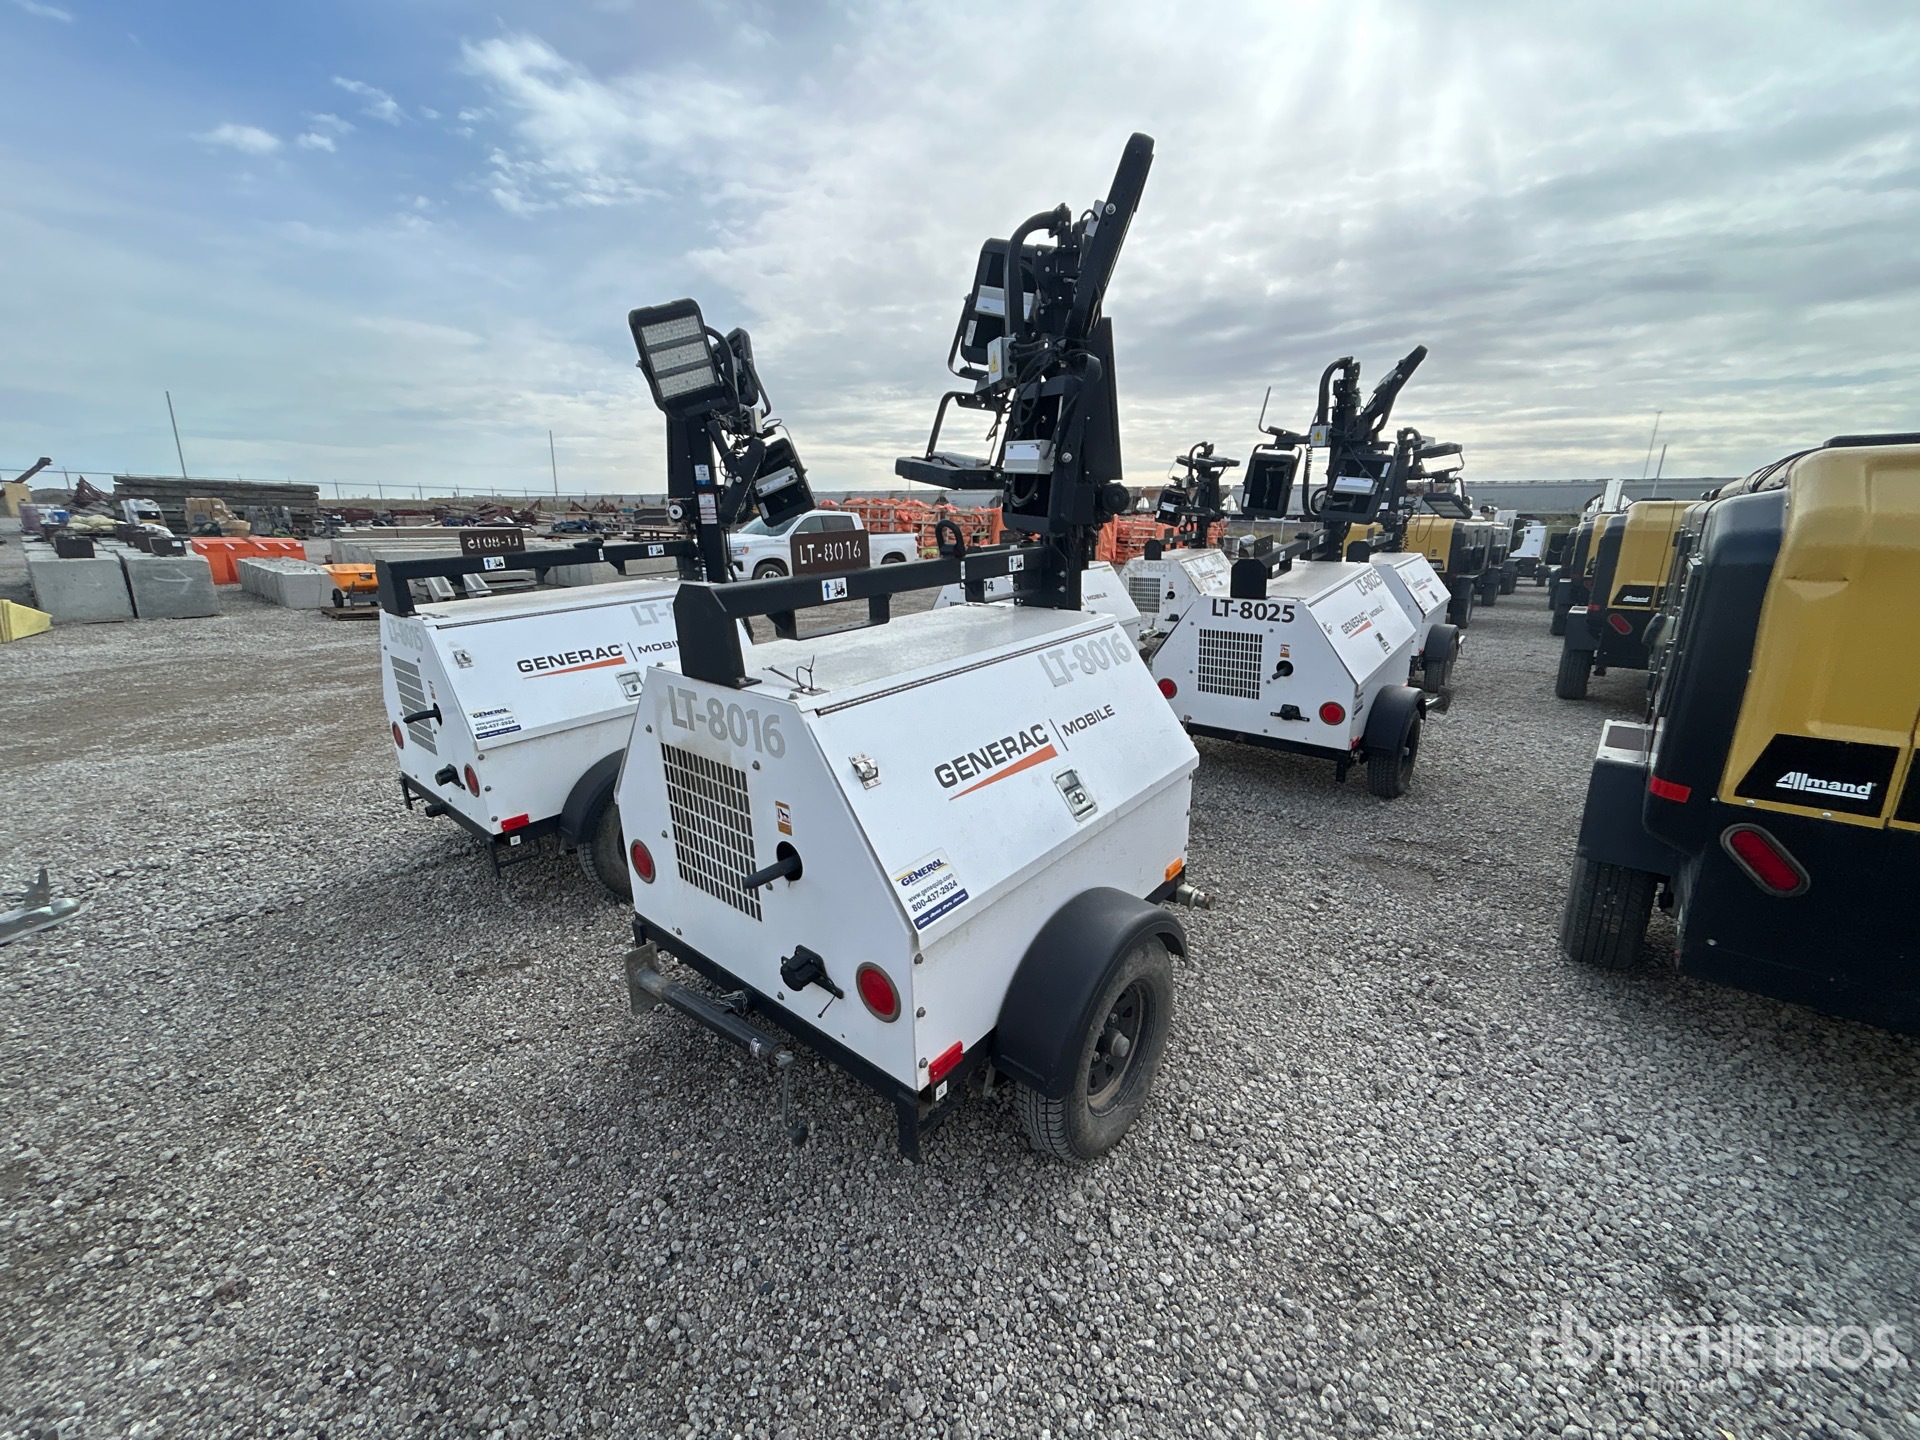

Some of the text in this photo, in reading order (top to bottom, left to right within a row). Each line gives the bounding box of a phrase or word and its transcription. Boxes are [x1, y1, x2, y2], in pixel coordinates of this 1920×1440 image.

[799, 540, 861, 565] LT-8016
[1086, 592, 1108, 601] MOBILE
[1211, 598, 1295, 624] LT-8025
[1341, 611, 1368, 635] GENERAC
[516, 640, 679, 673] GENERAC MOBI
[1037, 632, 1132, 688] LT-8016
[667, 684, 786, 759] LT-8016
[934, 704, 1116, 788] GENERAC MOBILE
[1776, 771, 1873, 800] Allmand
[901, 859, 944, 886] GENERAL
[908, 872, 954, 903] www.genequip.com
[911, 879, 958, 913] 800-437-2924
